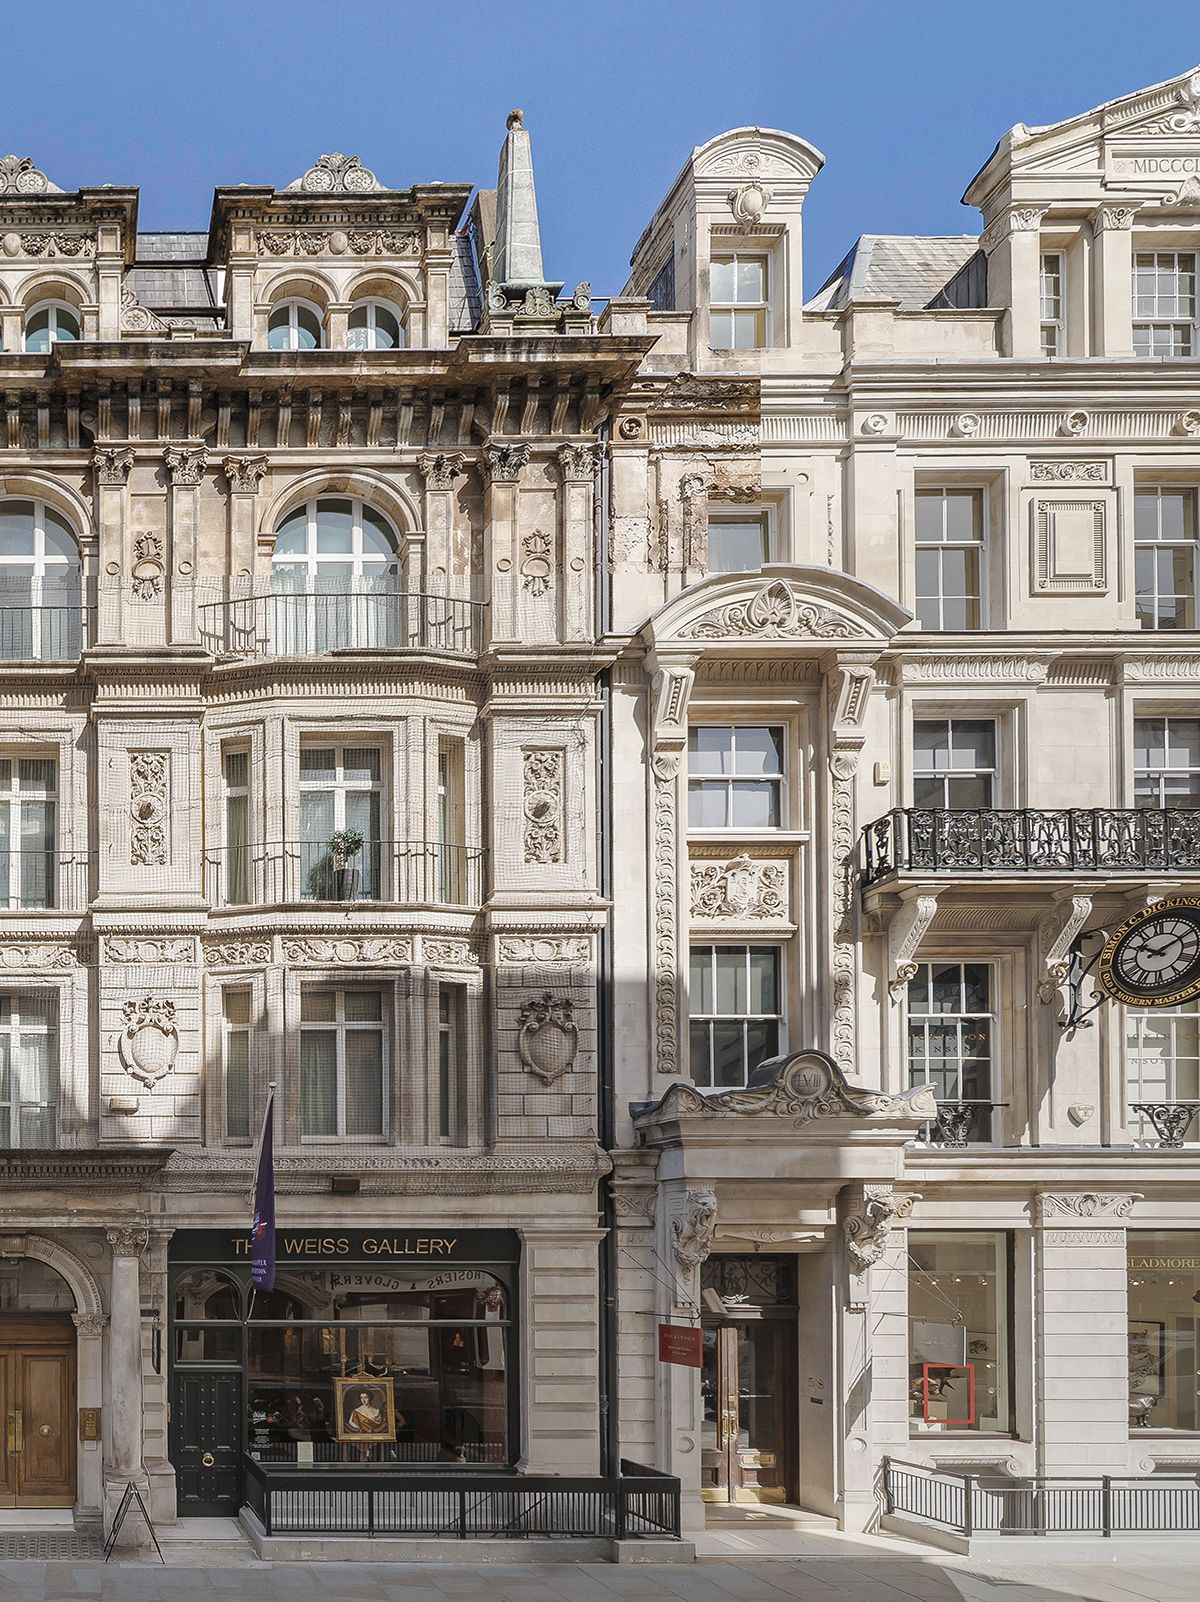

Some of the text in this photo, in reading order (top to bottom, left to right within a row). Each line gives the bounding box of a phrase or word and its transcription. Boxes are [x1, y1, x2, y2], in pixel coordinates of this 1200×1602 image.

[1102, 925, 1129, 960] SIMON
[1103, 973, 1114, 988] OLD
[1115, 991, 1153, 1006] MODERN
[1154, 987, 1196, 1005] MASTER
[231, 1238, 458, 1255] TH WEISS GALLERY
[663, 1333, 696, 1341] DICKINSON
[807, 1377, 825, 1389] 58
